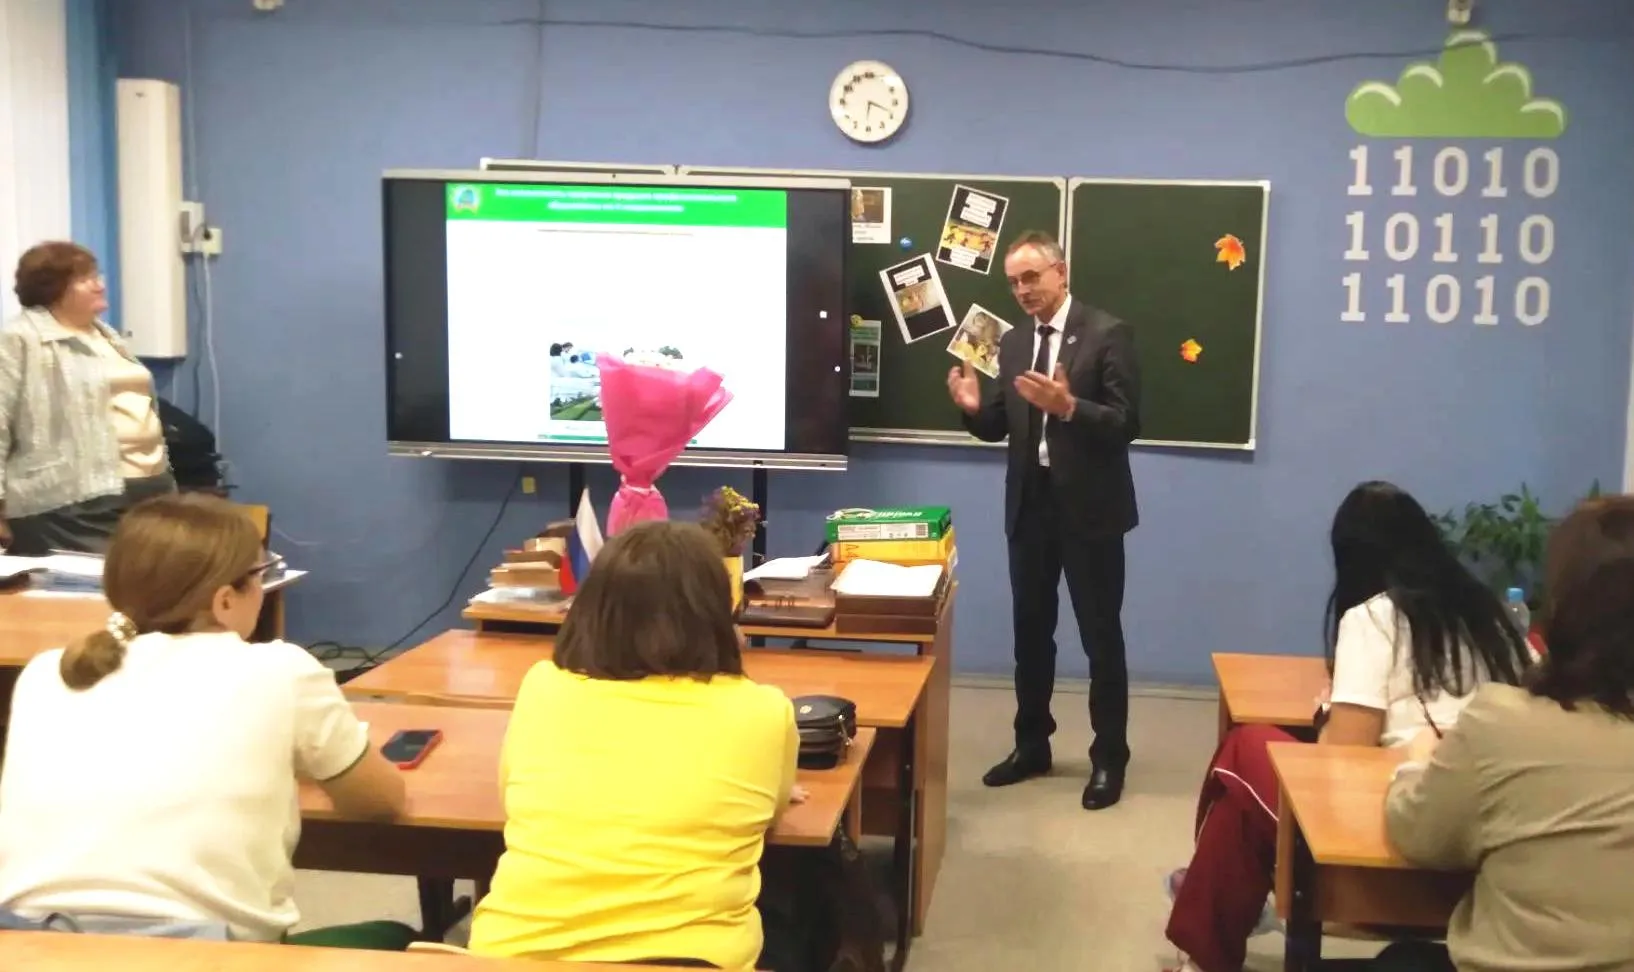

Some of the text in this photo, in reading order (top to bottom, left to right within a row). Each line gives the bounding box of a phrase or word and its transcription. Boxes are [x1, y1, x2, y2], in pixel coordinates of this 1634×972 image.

[1347, 144, 1560, 198] 11010
[1343, 210, 1555, 264] 10110
[1340, 272, 1551, 327] 11010
